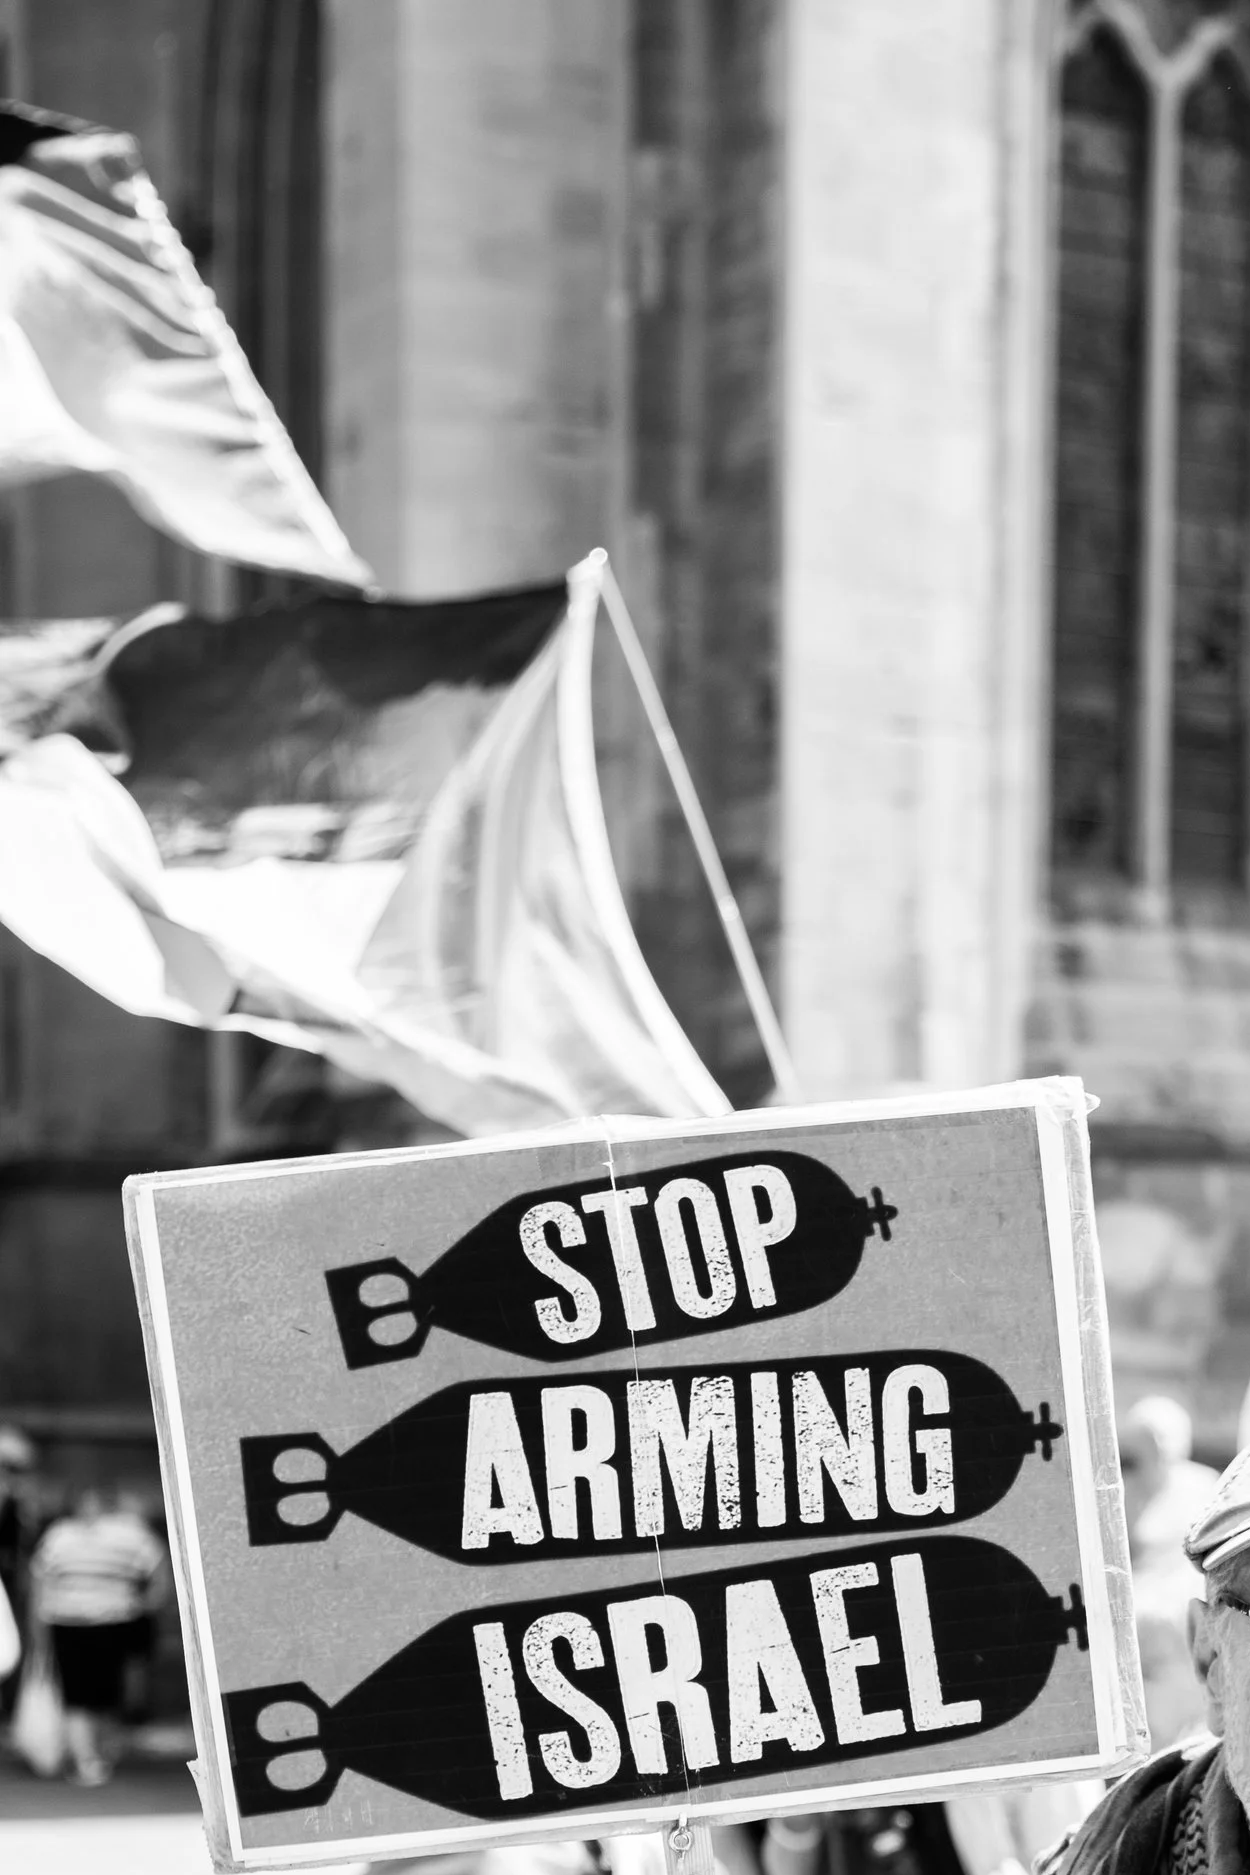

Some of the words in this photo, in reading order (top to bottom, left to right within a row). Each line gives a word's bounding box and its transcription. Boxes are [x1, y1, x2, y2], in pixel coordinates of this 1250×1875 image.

[518, 1165, 797, 1345] STOP
[460, 1364, 957, 1550] ARMING
[472, 1553, 984, 1801] ISRAEL
